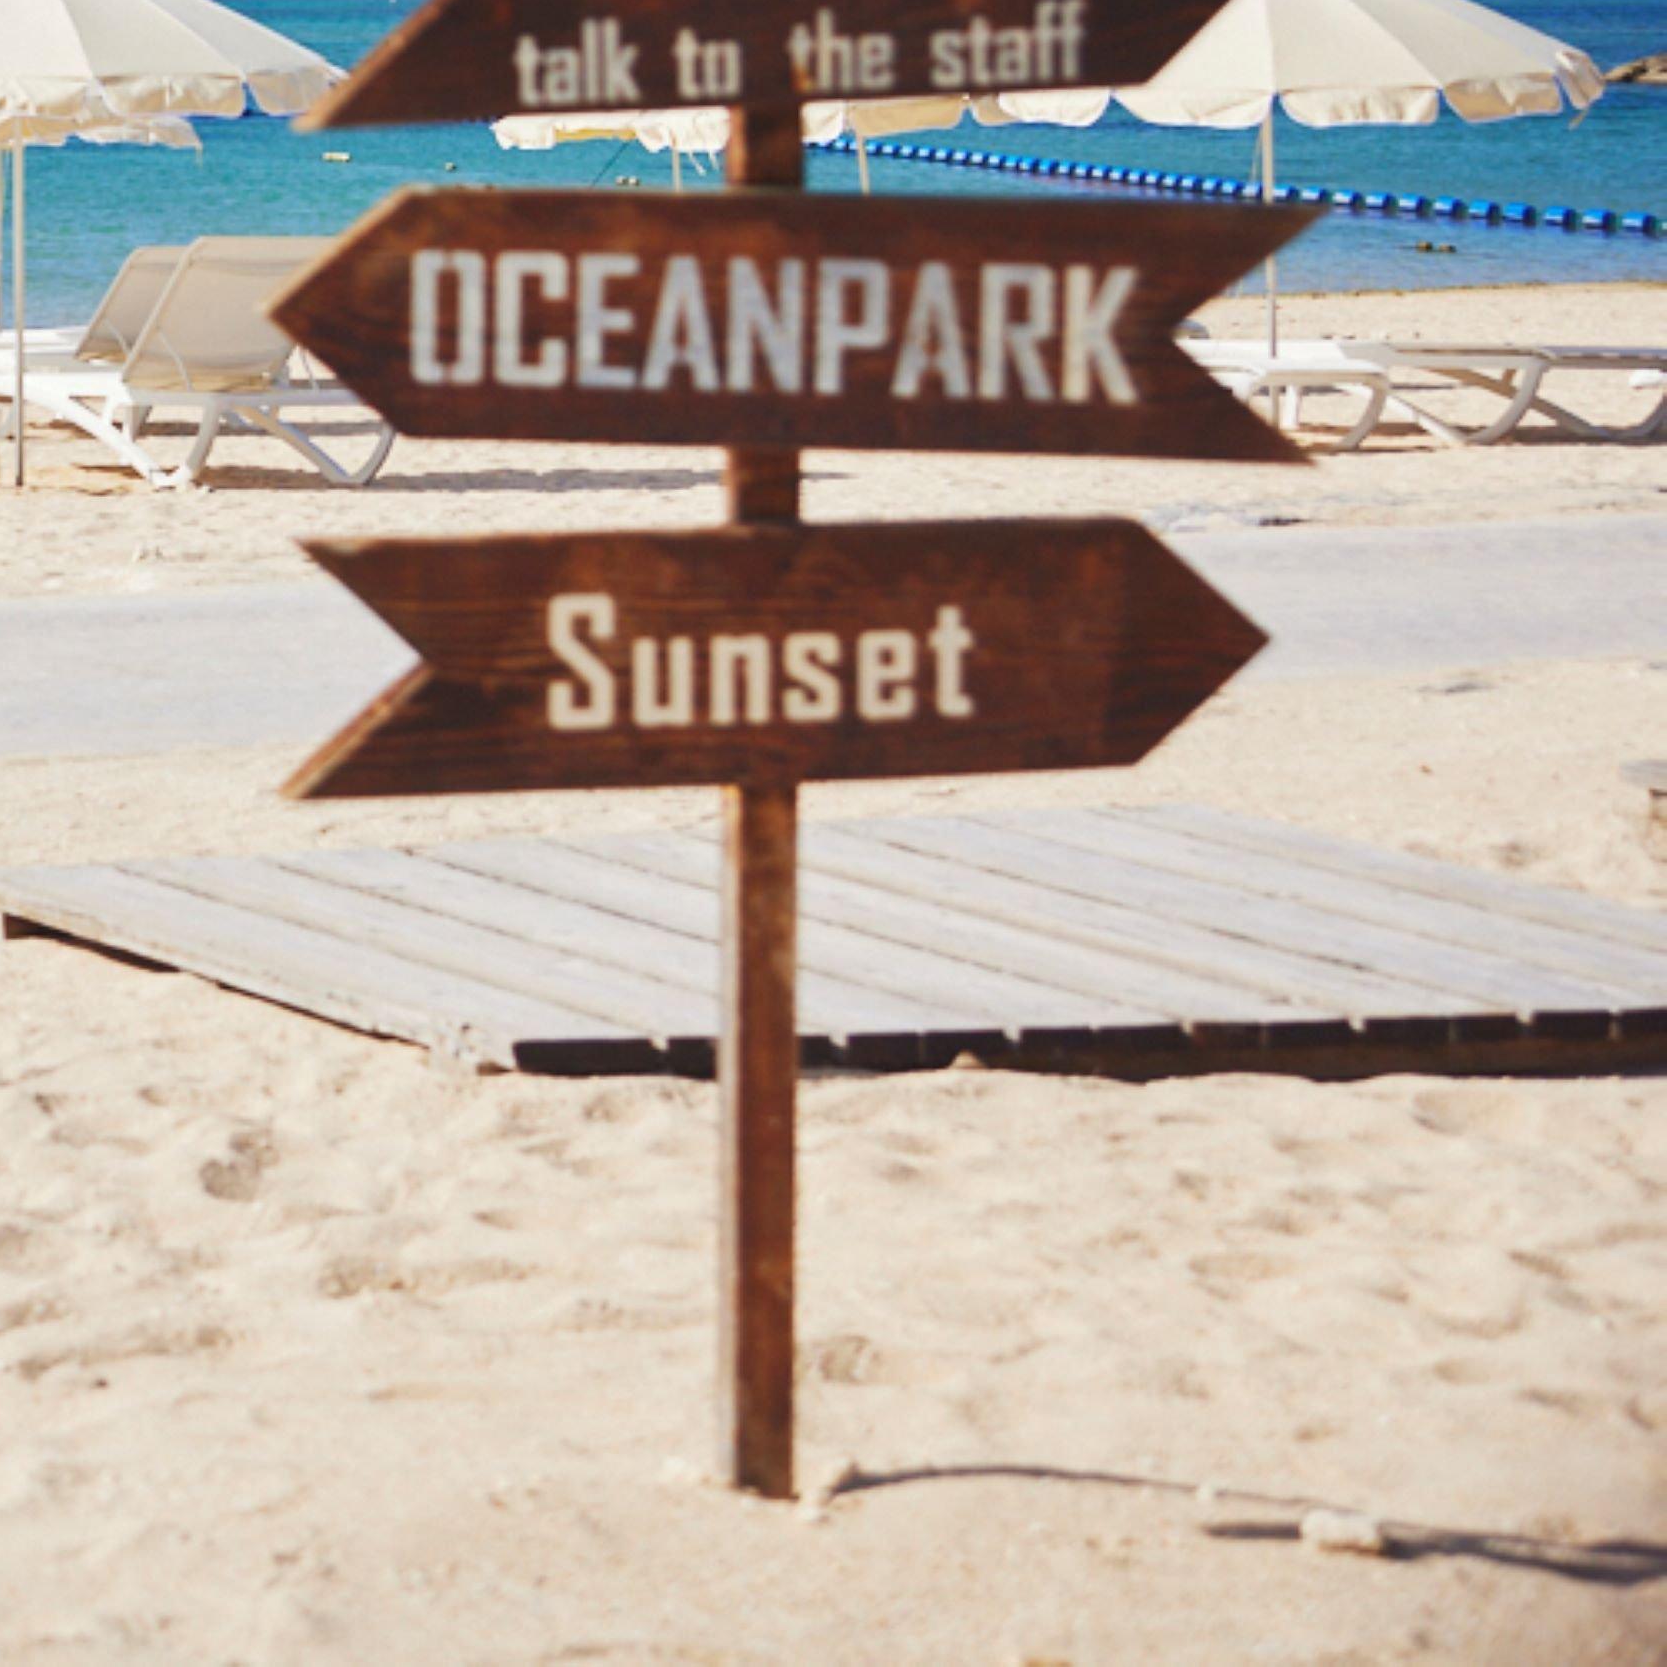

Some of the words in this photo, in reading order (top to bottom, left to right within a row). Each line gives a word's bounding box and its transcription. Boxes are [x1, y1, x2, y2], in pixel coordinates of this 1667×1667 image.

[514, 18, 640, 106] talk
[673, 28, 742, 100] to
[789, 10, 896, 93] the
[929, 0, 1087, 87] staff
[409, 247, 1138, 405] OCEANPARK
[547, 591, 975, 731] Sunset
